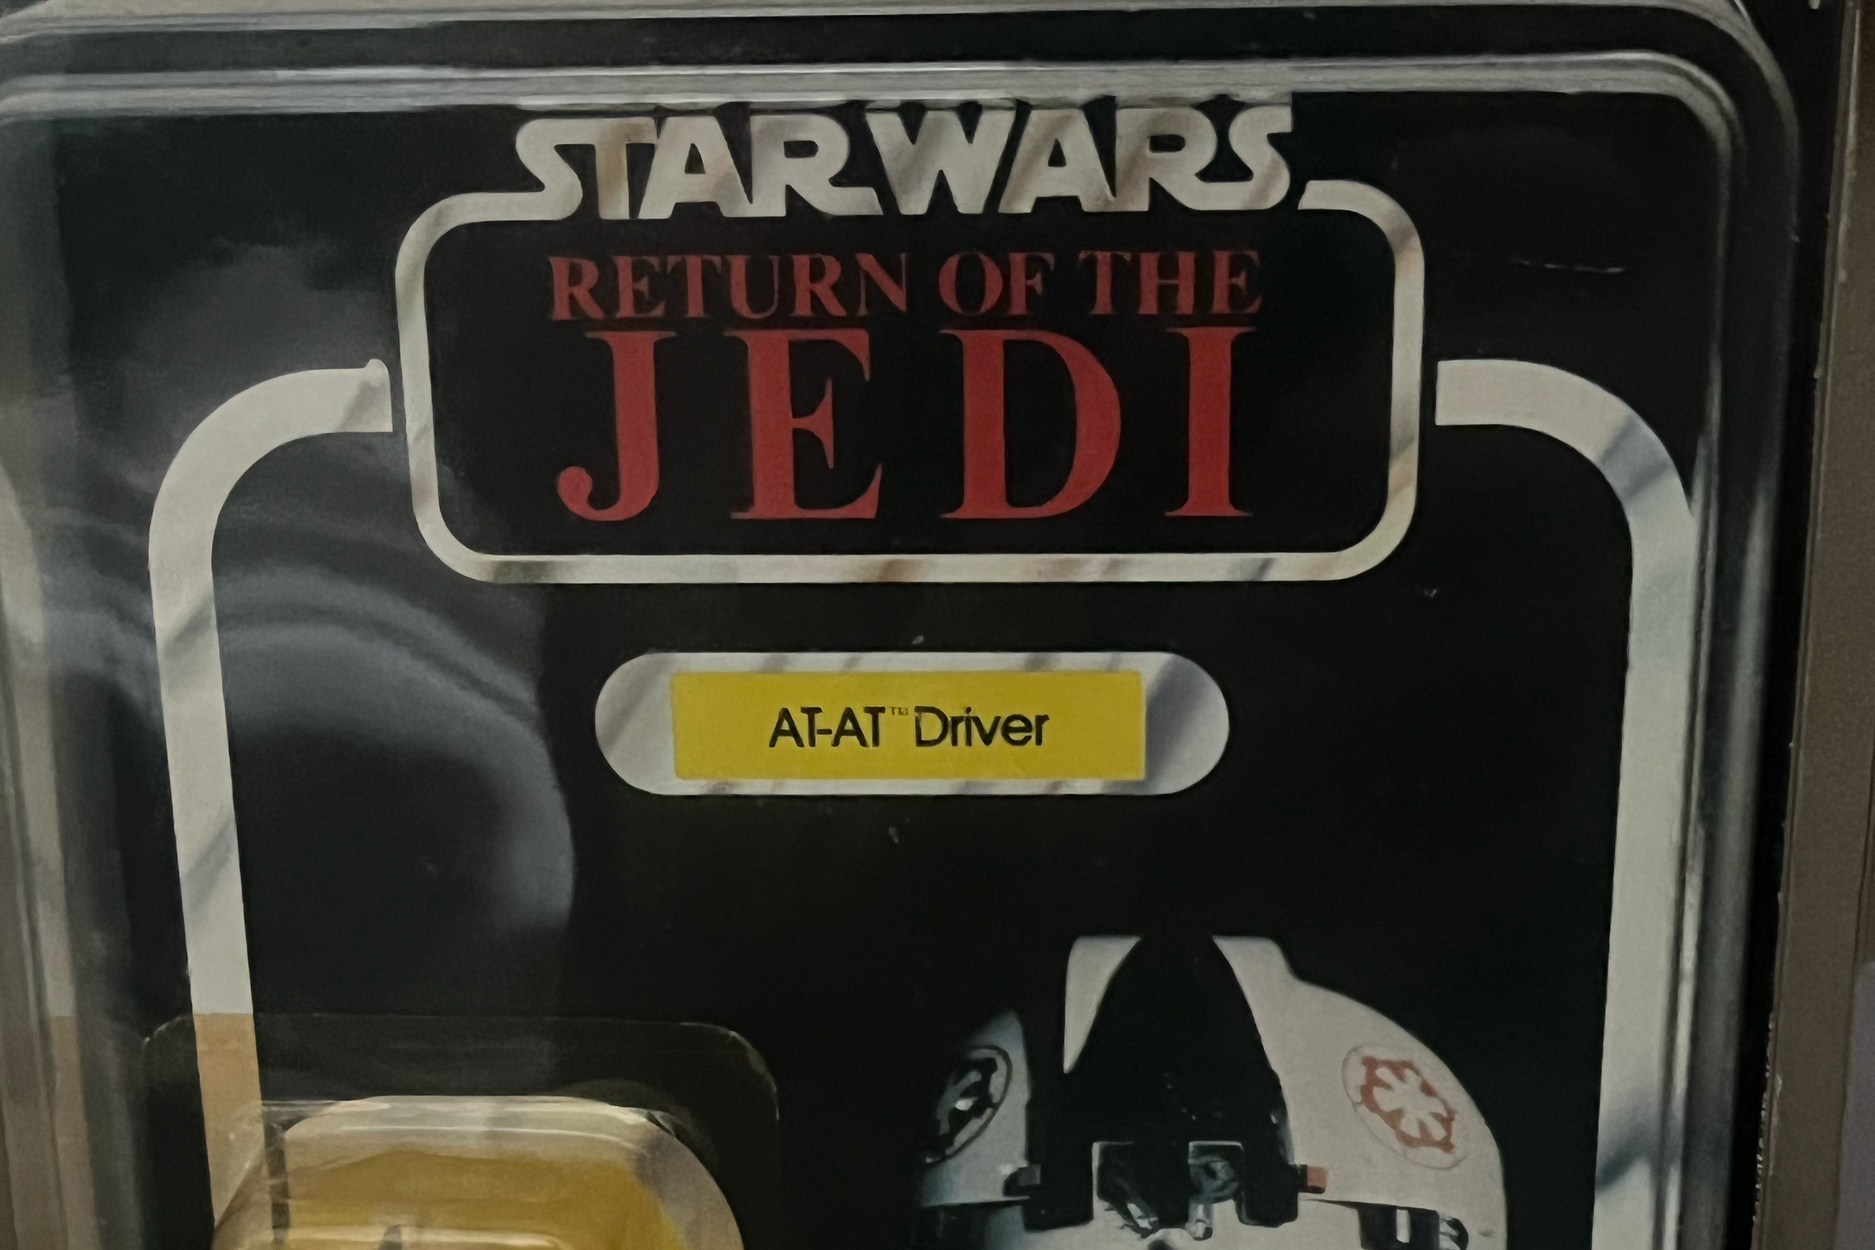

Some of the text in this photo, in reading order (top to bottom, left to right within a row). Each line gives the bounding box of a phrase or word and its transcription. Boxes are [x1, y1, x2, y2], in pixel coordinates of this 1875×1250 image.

[548, 249, 1263, 322] RETURN OF THE
[555, 324, 1256, 521] JEDI
[913, 705, 1050, 748] Driver
